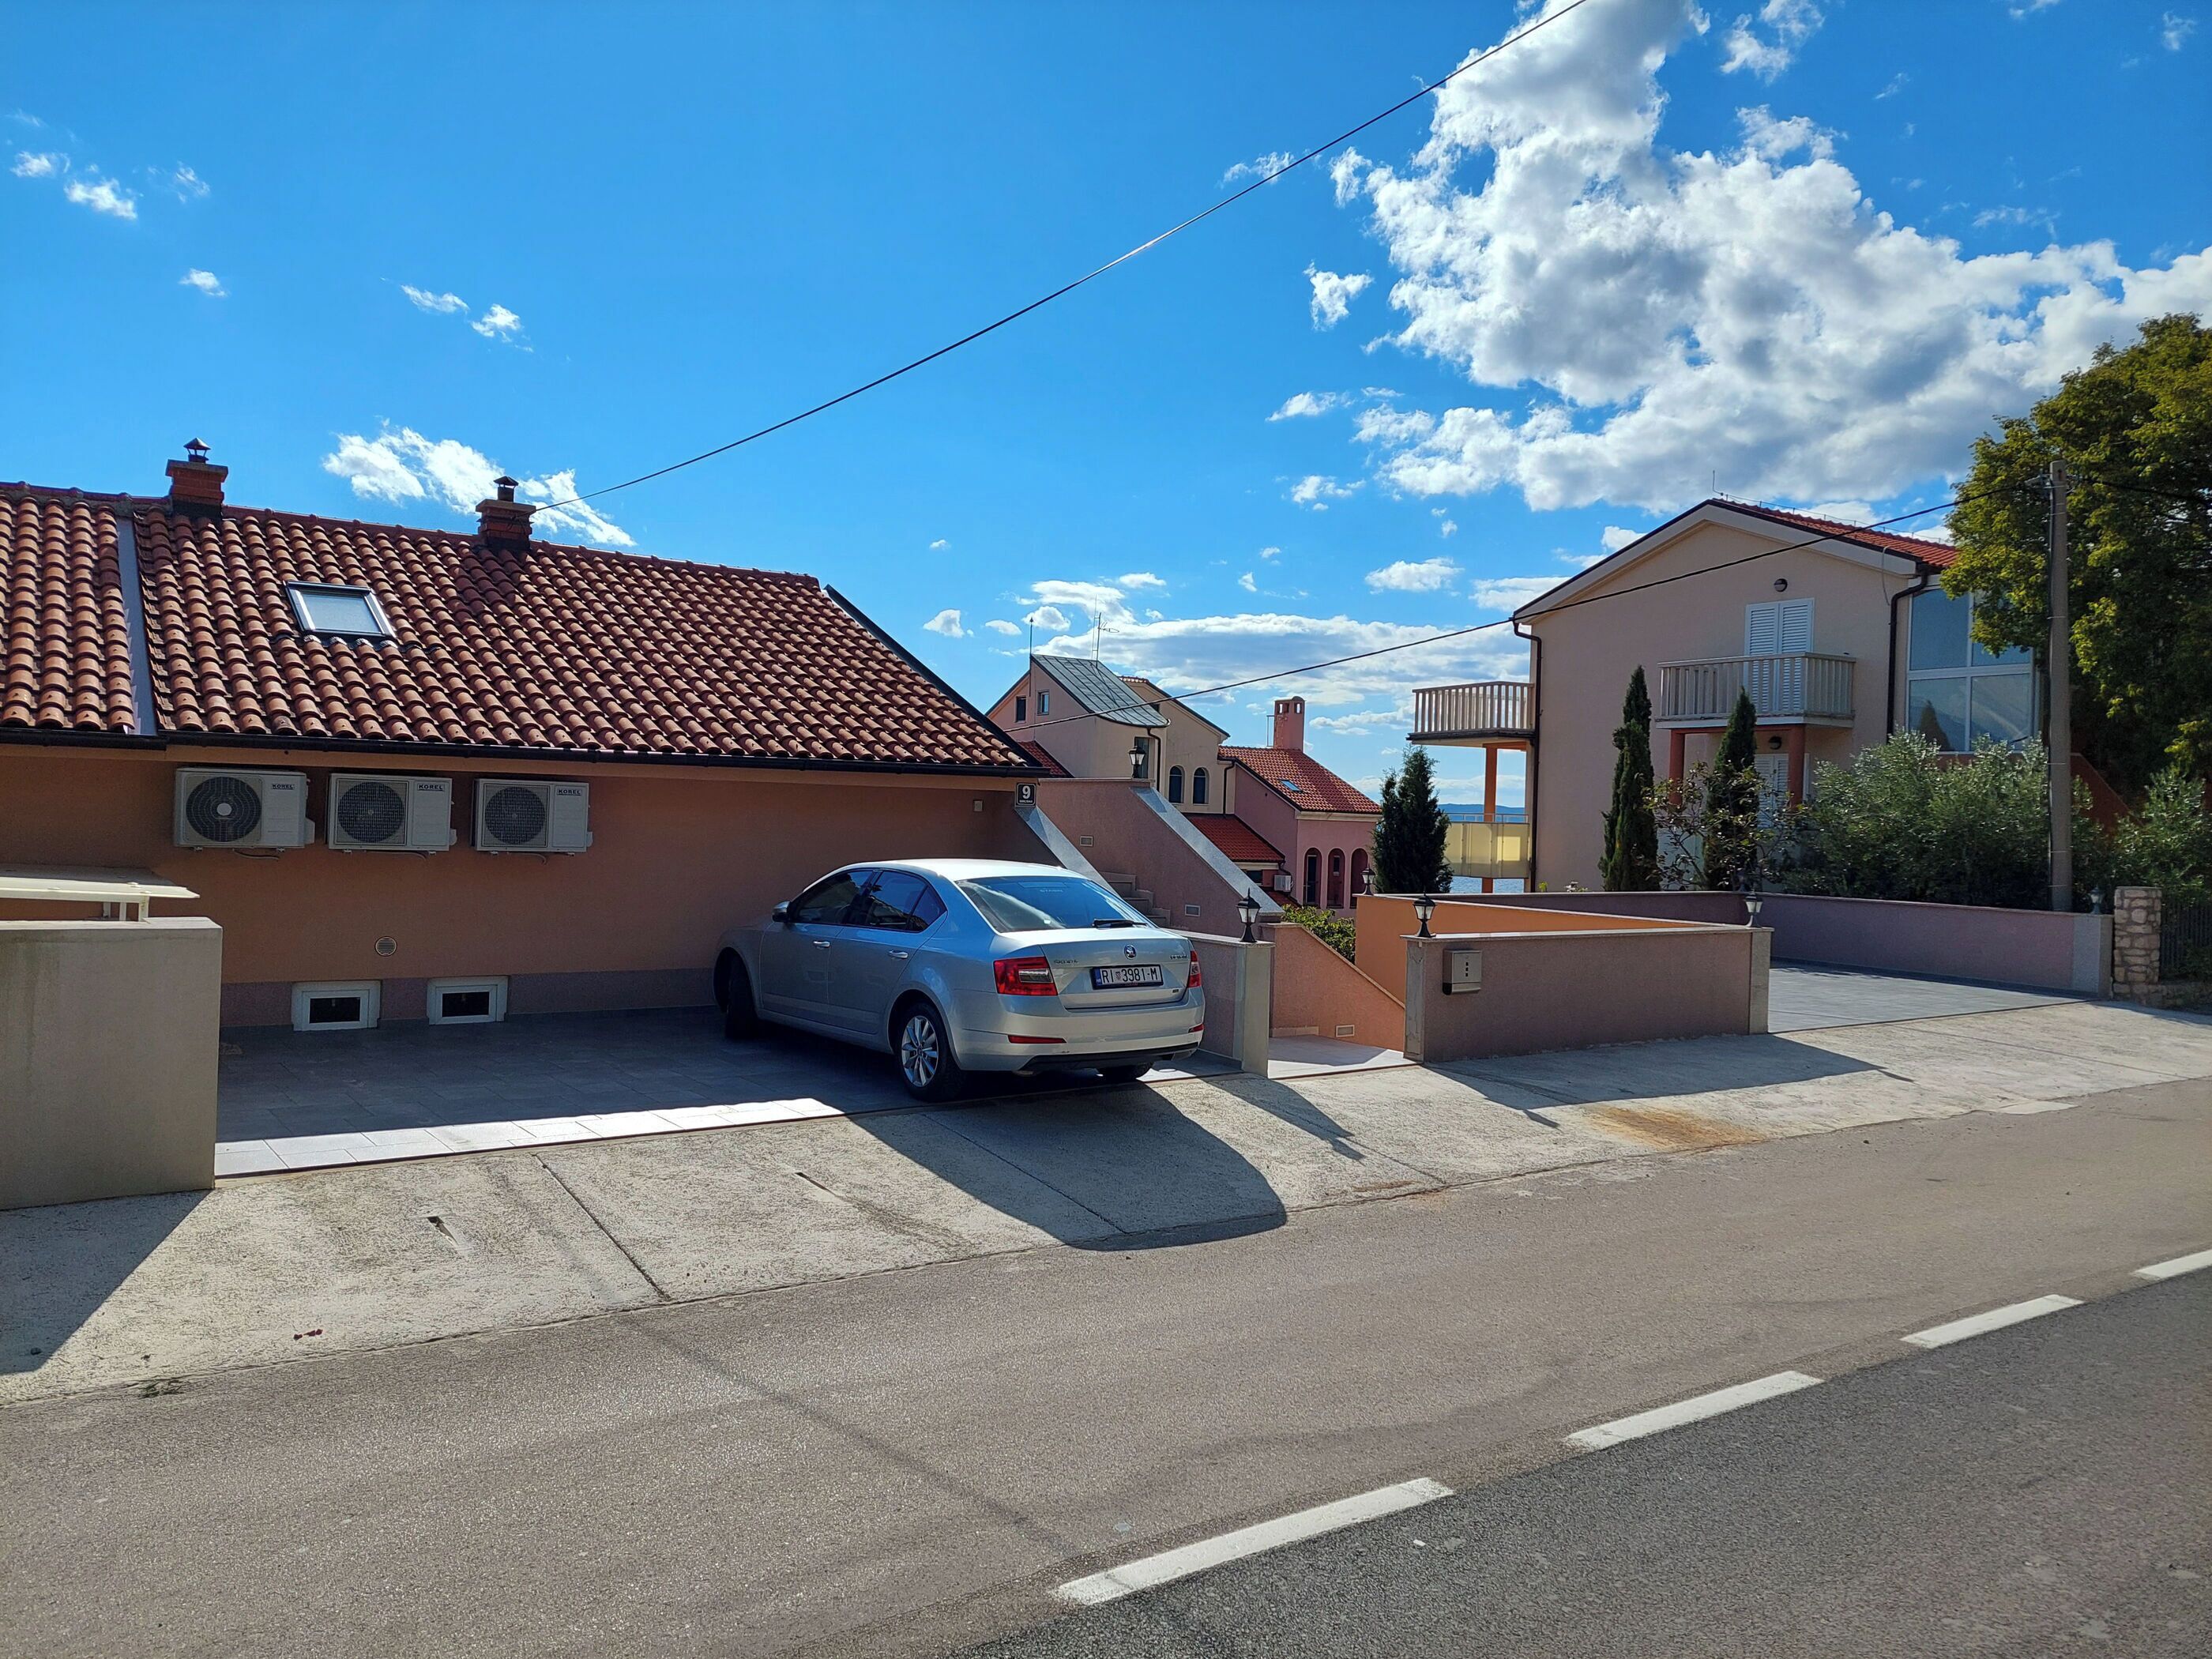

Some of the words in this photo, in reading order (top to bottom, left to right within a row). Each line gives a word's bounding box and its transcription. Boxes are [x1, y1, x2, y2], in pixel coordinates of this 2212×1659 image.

[1022, 785, 1031, 799] 9
[1101, 969, 1114, 984] RI
[1121, 967, 1158, 982] 3981-M
